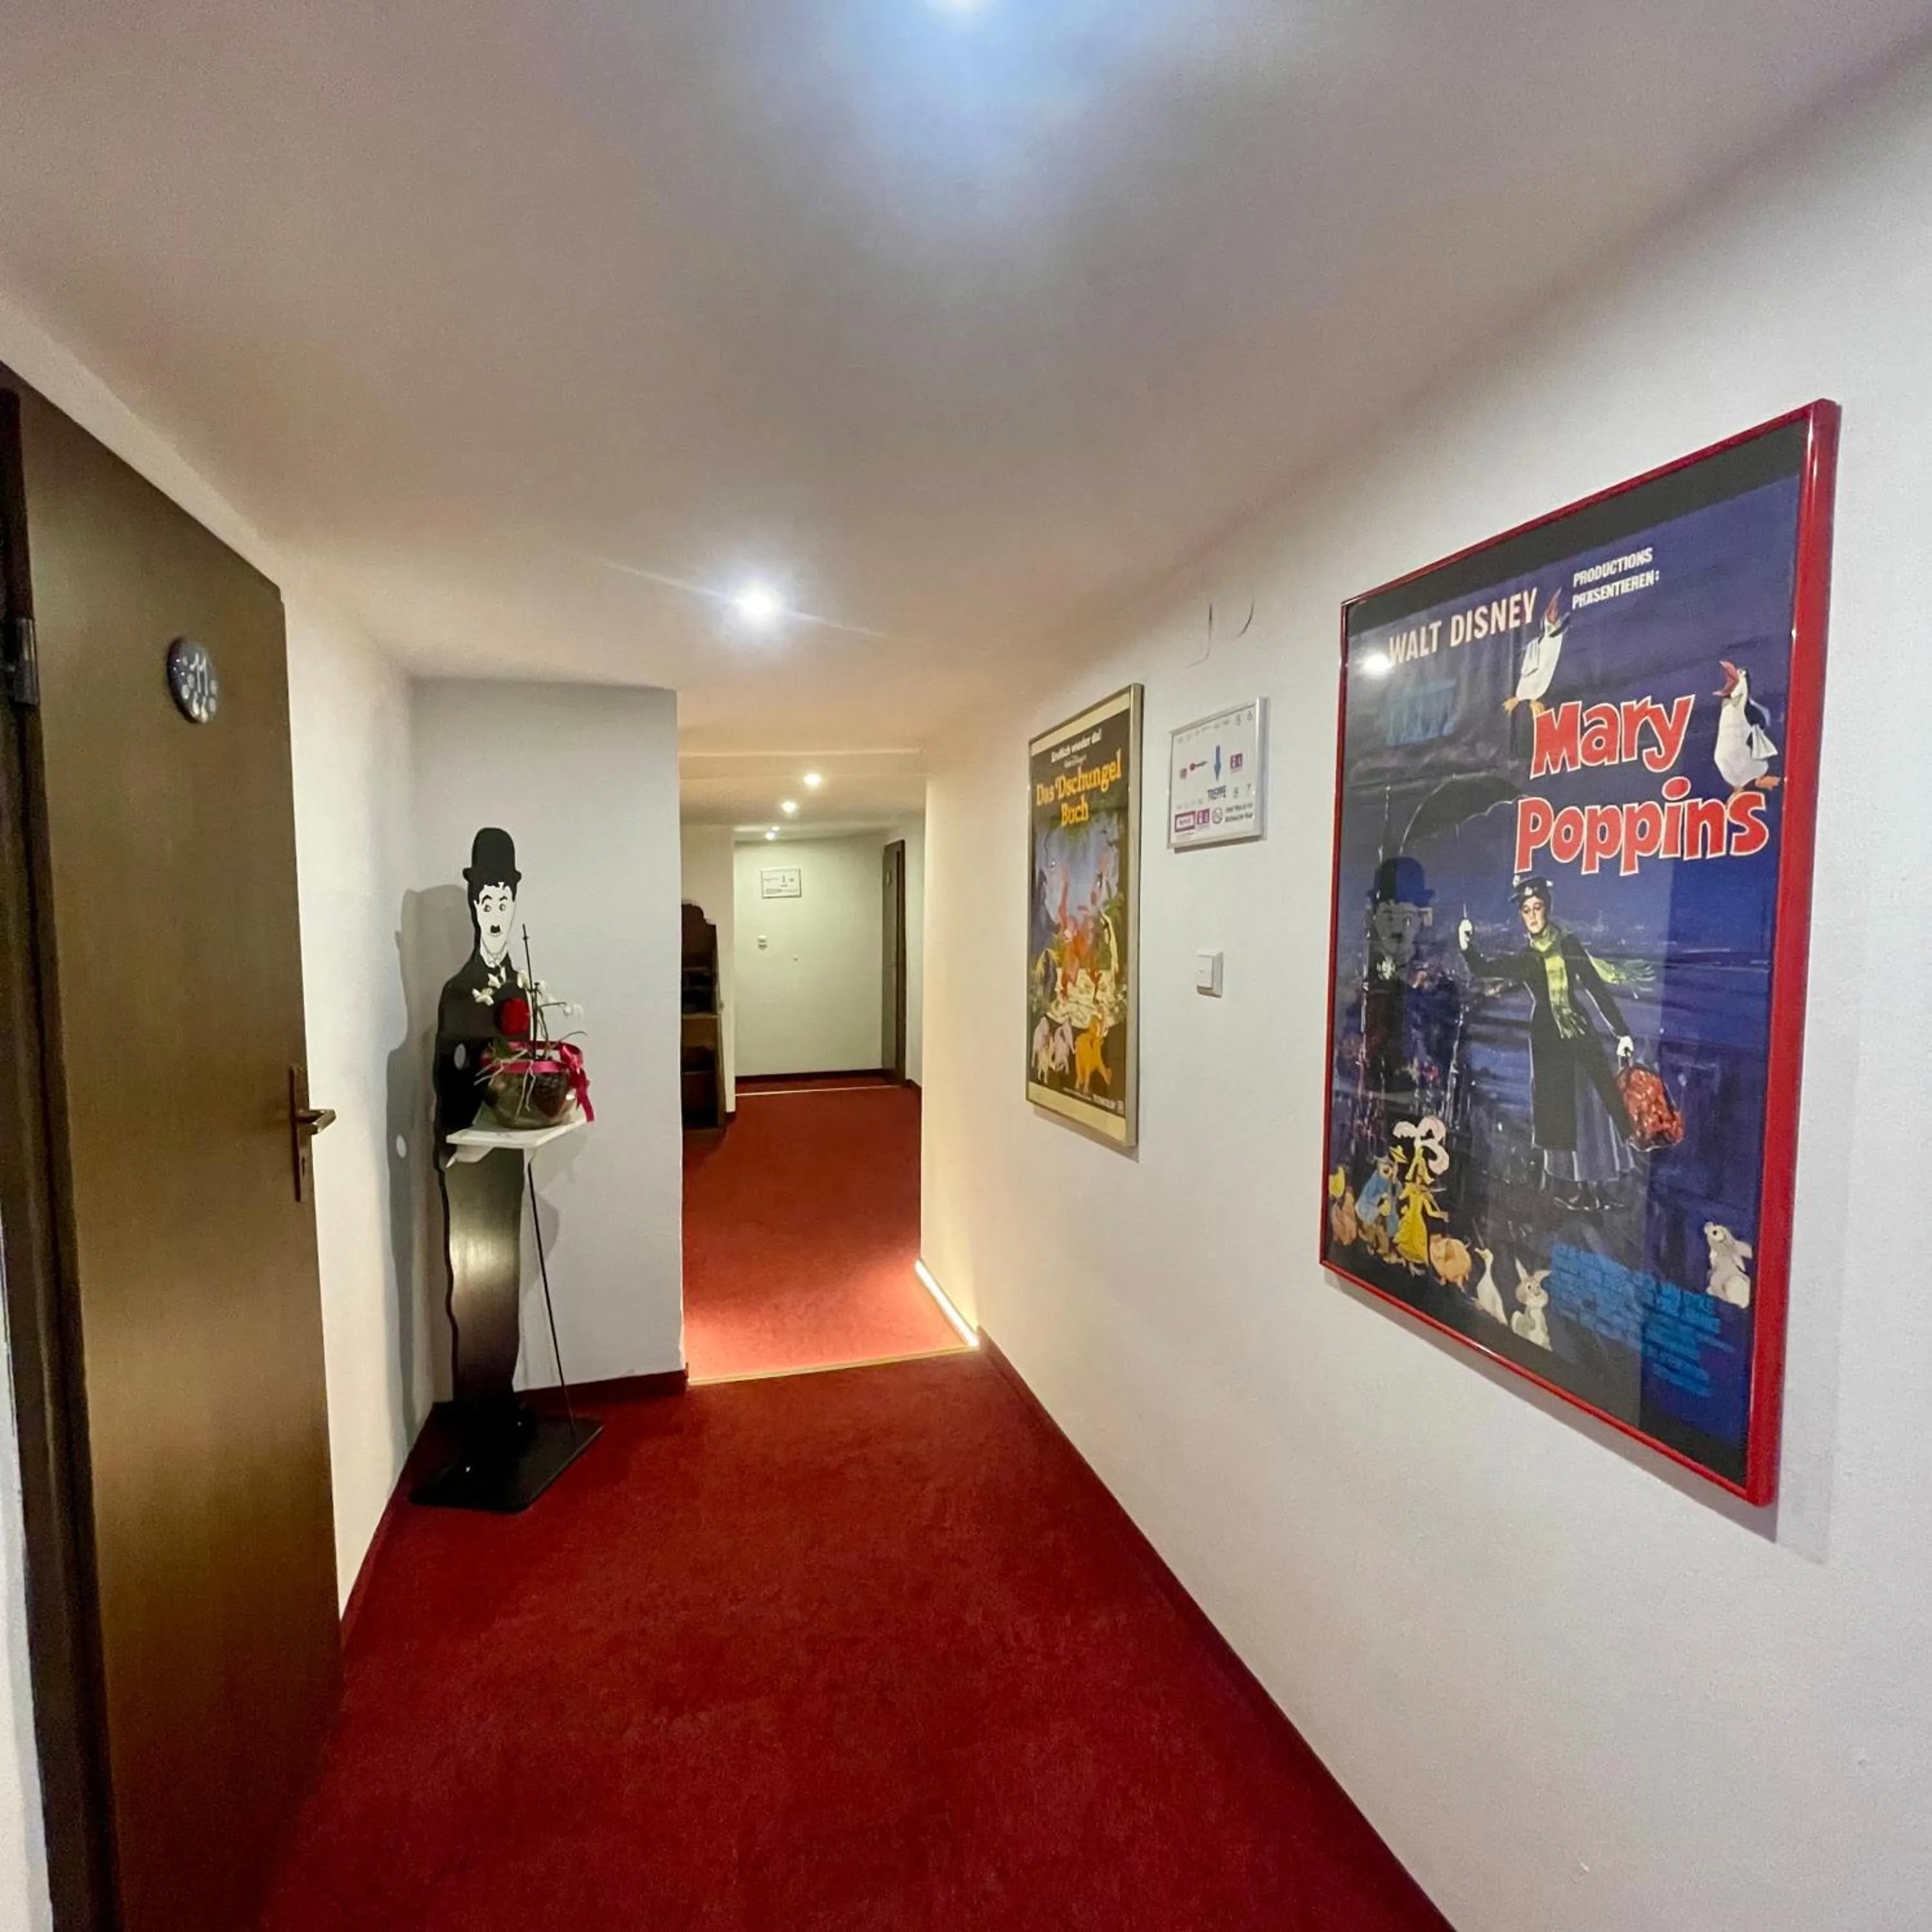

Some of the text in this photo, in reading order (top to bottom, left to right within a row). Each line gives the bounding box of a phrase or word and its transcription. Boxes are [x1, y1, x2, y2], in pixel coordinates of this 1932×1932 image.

[1573, 547, 1654, 588] PRODUCTIONS
[1389, 587, 1537, 664] WALT DISNEY
[1530, 694, 1696, 780] Mary
[1036, 782, 1055, 806] Das
[1054, 747, 1122, 793] Dschungel
[1061, 793, 1090, 827] Buch
[1514, 776, 1770, 876] Poppins
